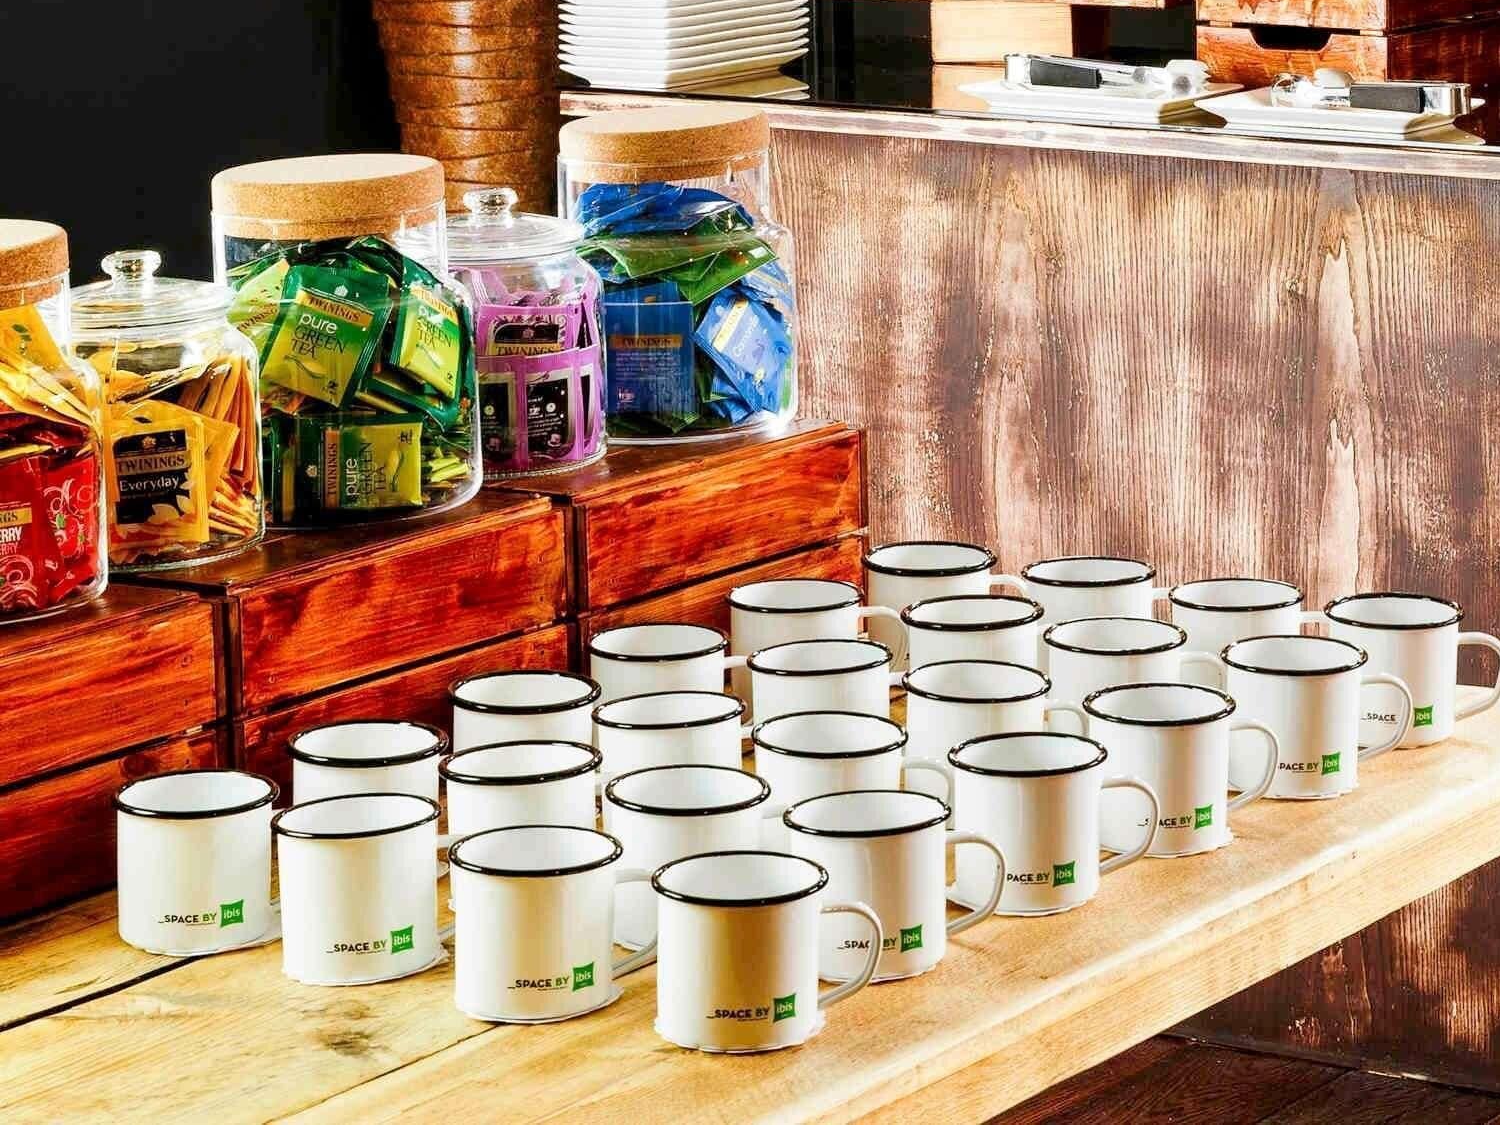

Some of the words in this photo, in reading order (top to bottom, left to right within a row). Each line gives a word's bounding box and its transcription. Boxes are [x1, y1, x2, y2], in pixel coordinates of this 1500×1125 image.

[308, 296, 361, 323] TWININGS
[300, 313, 338, 335] pure
[290, 338, 317, 359] TEA
[294, 326, 346, 355] GREEN
[117, 454, 185, 473] TWININGS
[327, 443, 338, 496] TWININGS
[119, 476, 180, 492] Everyday
[345, 458, 358, 497] pure
[1306, 762, 1319, 770] BY
[1180, 816, 1192, 825] BY
[1036, 873, 1049, 881] BY
[202, 912, 217, 922] BY
[223, 907, 241, 919] ibis
[373, 938, 387, 949] BY
[393, 933, 410, 946] ibis
[882, 937, 897, 947] BY
[555, 975, 569, 987] BY
[575, 969, 592, 982] ibis
[755, 1006, 769, 1017] BY
[776, 1001, 793, 1014] ibis
